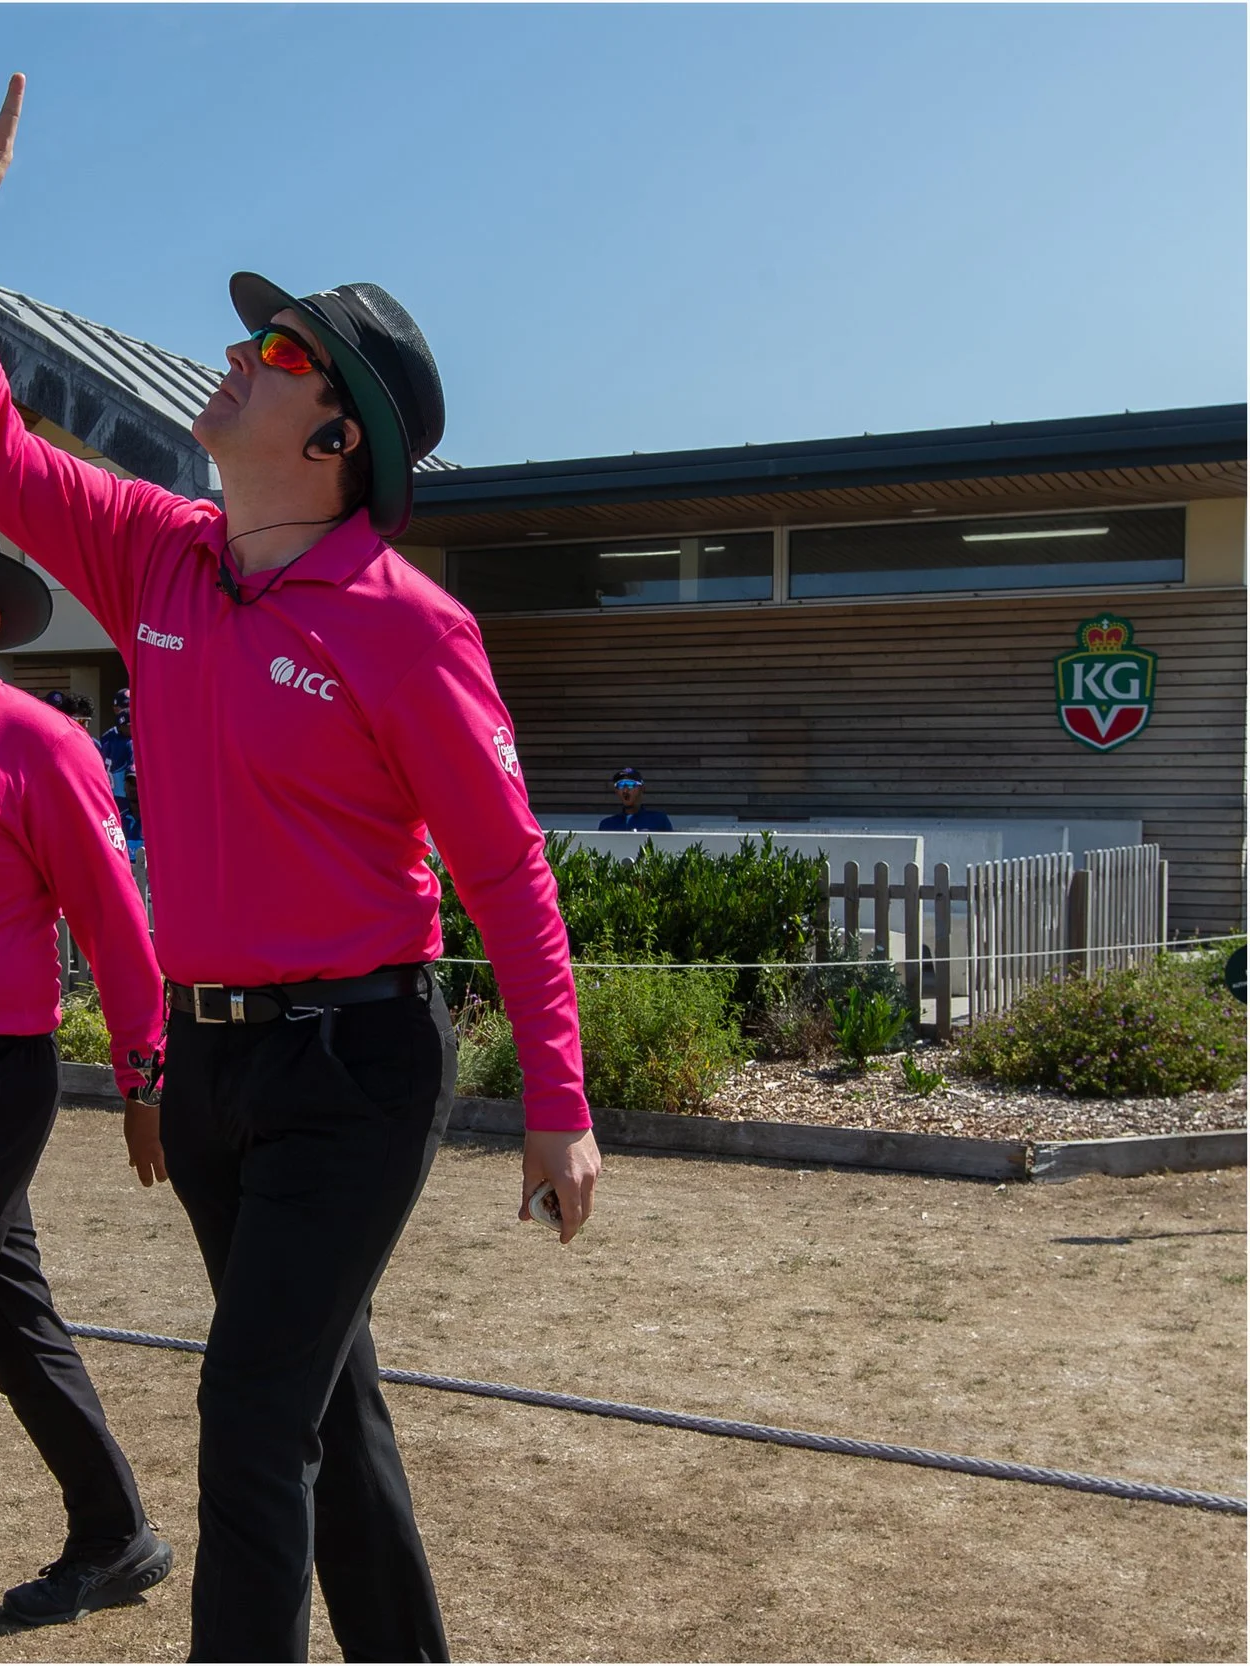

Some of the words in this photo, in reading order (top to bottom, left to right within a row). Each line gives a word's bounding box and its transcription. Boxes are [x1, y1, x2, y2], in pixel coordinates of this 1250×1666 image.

[137, 623, 184, 651] Emirates
[293, 667, 340, 701] ICC
[1071, 661, 1140, 700] KG
